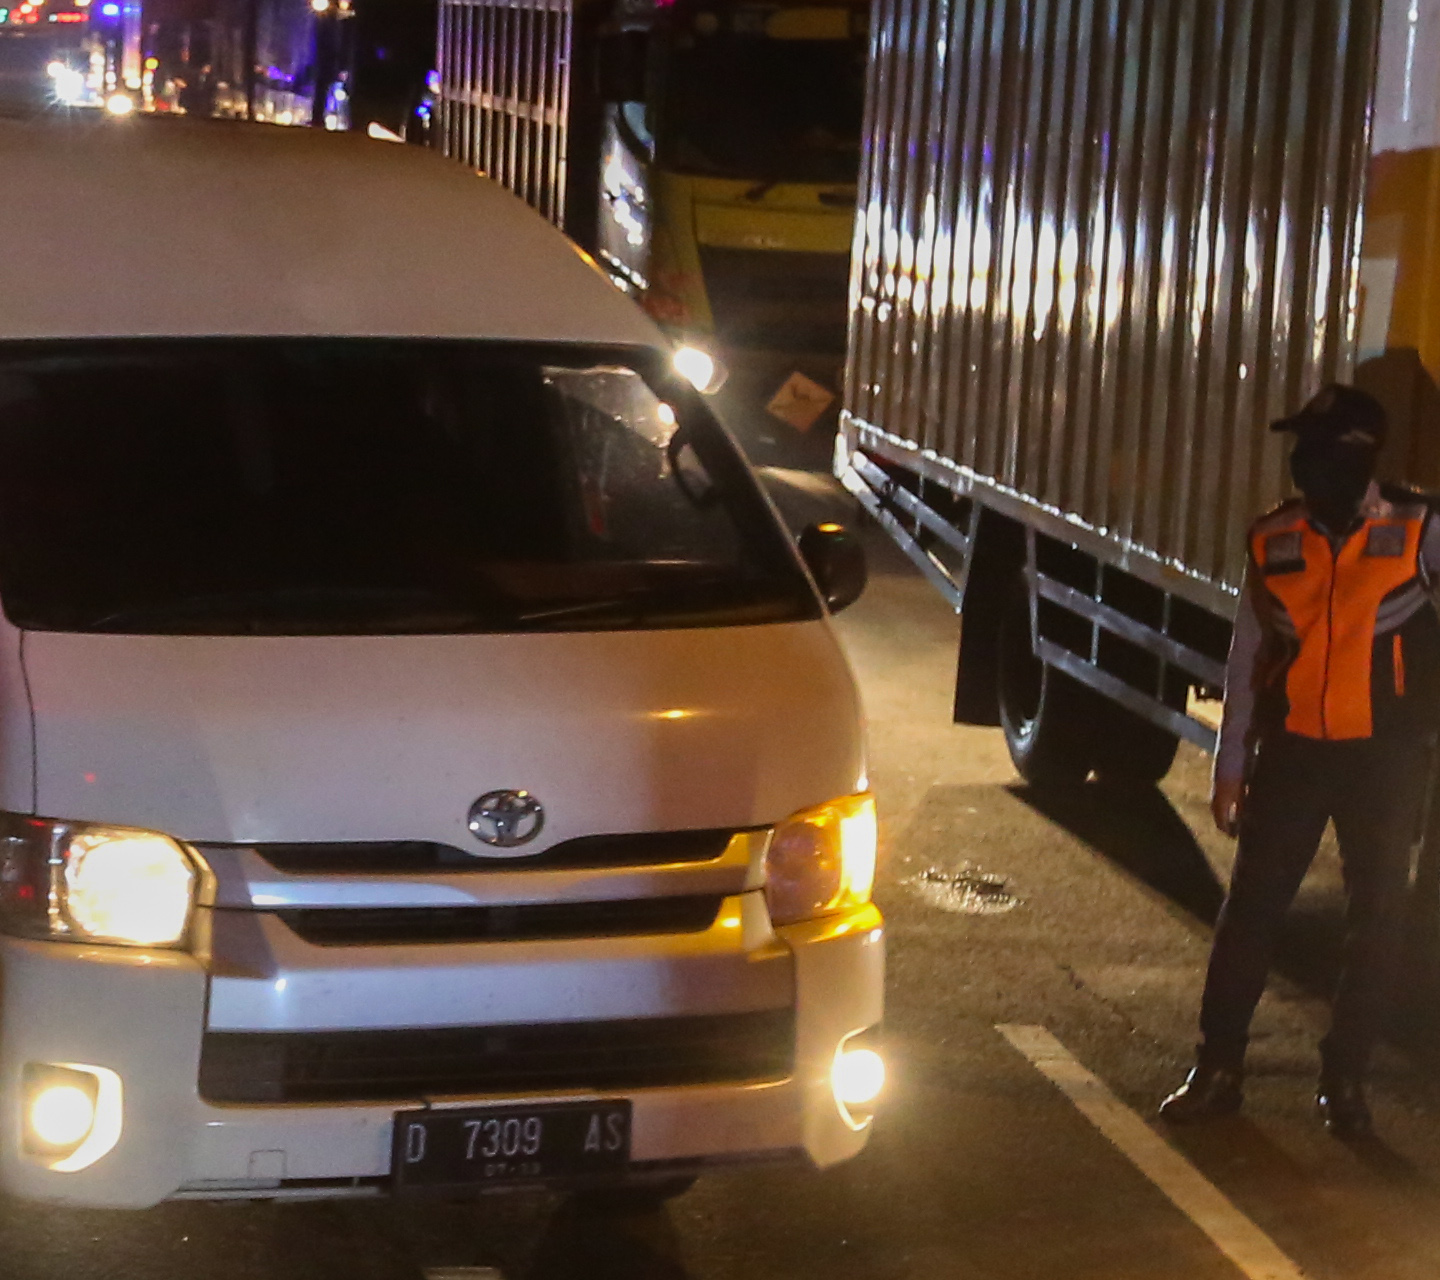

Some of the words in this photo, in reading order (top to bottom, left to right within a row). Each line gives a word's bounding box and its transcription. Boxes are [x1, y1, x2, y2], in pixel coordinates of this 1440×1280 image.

[405, 1122, 428, 1164] D
[463, 1116, 543, 1160] 7309
[584, 1113, 624, 1152] AS
